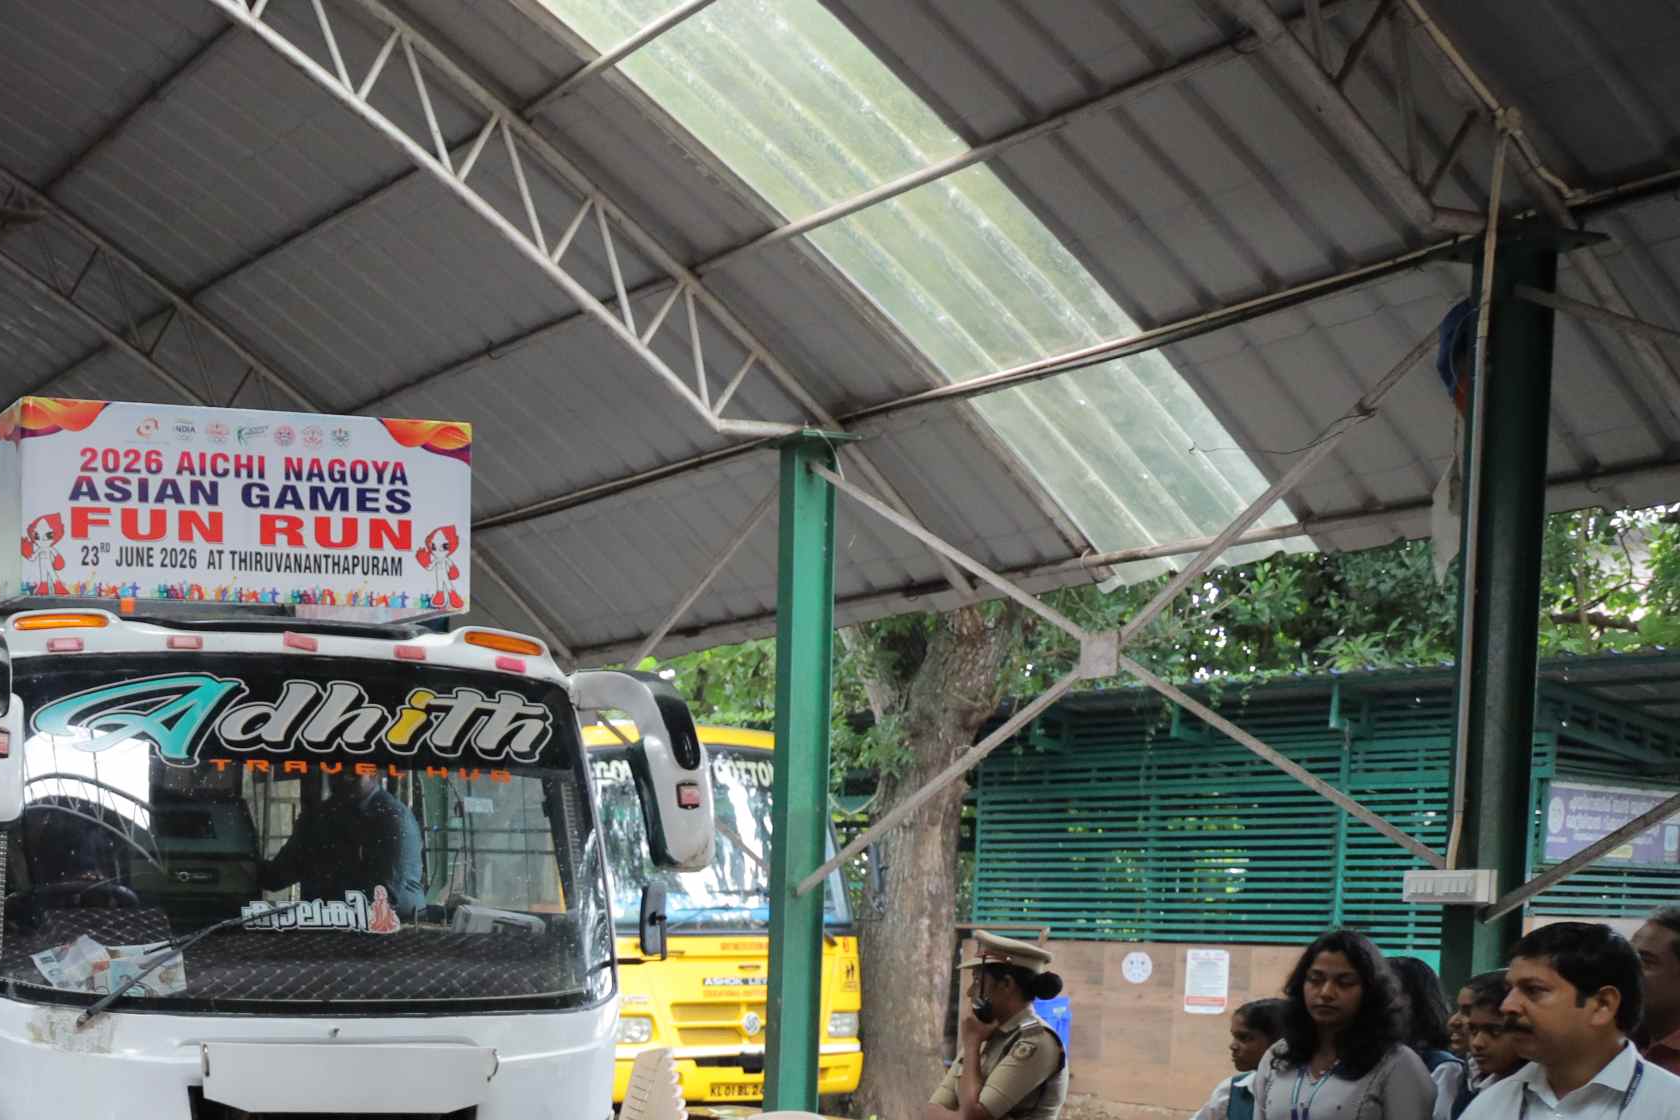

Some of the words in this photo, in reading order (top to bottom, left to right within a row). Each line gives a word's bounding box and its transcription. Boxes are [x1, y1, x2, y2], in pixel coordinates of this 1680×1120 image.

[79, 447, 164, 475] 2026
[175, 451, 265, 480] AICHI
[283, 456, 409, 486] NAGOYA
[68, 475, 220, 506] ASIAN
[241, 482, 412, 514] GAMES
[70, 506, 224, 544] FUN
[259, 513, 413, 551] RUN
[115, 546, 154, 568] JUNE
[159, 547, 197, 569] 2026
[207, 551, 224, 570] AT
[230, 550, 403, 577] THIRUVANANTHAPURAM
[209, 758, 407, 778] TRAVEL
[426, 765, 512, 783] HUB
